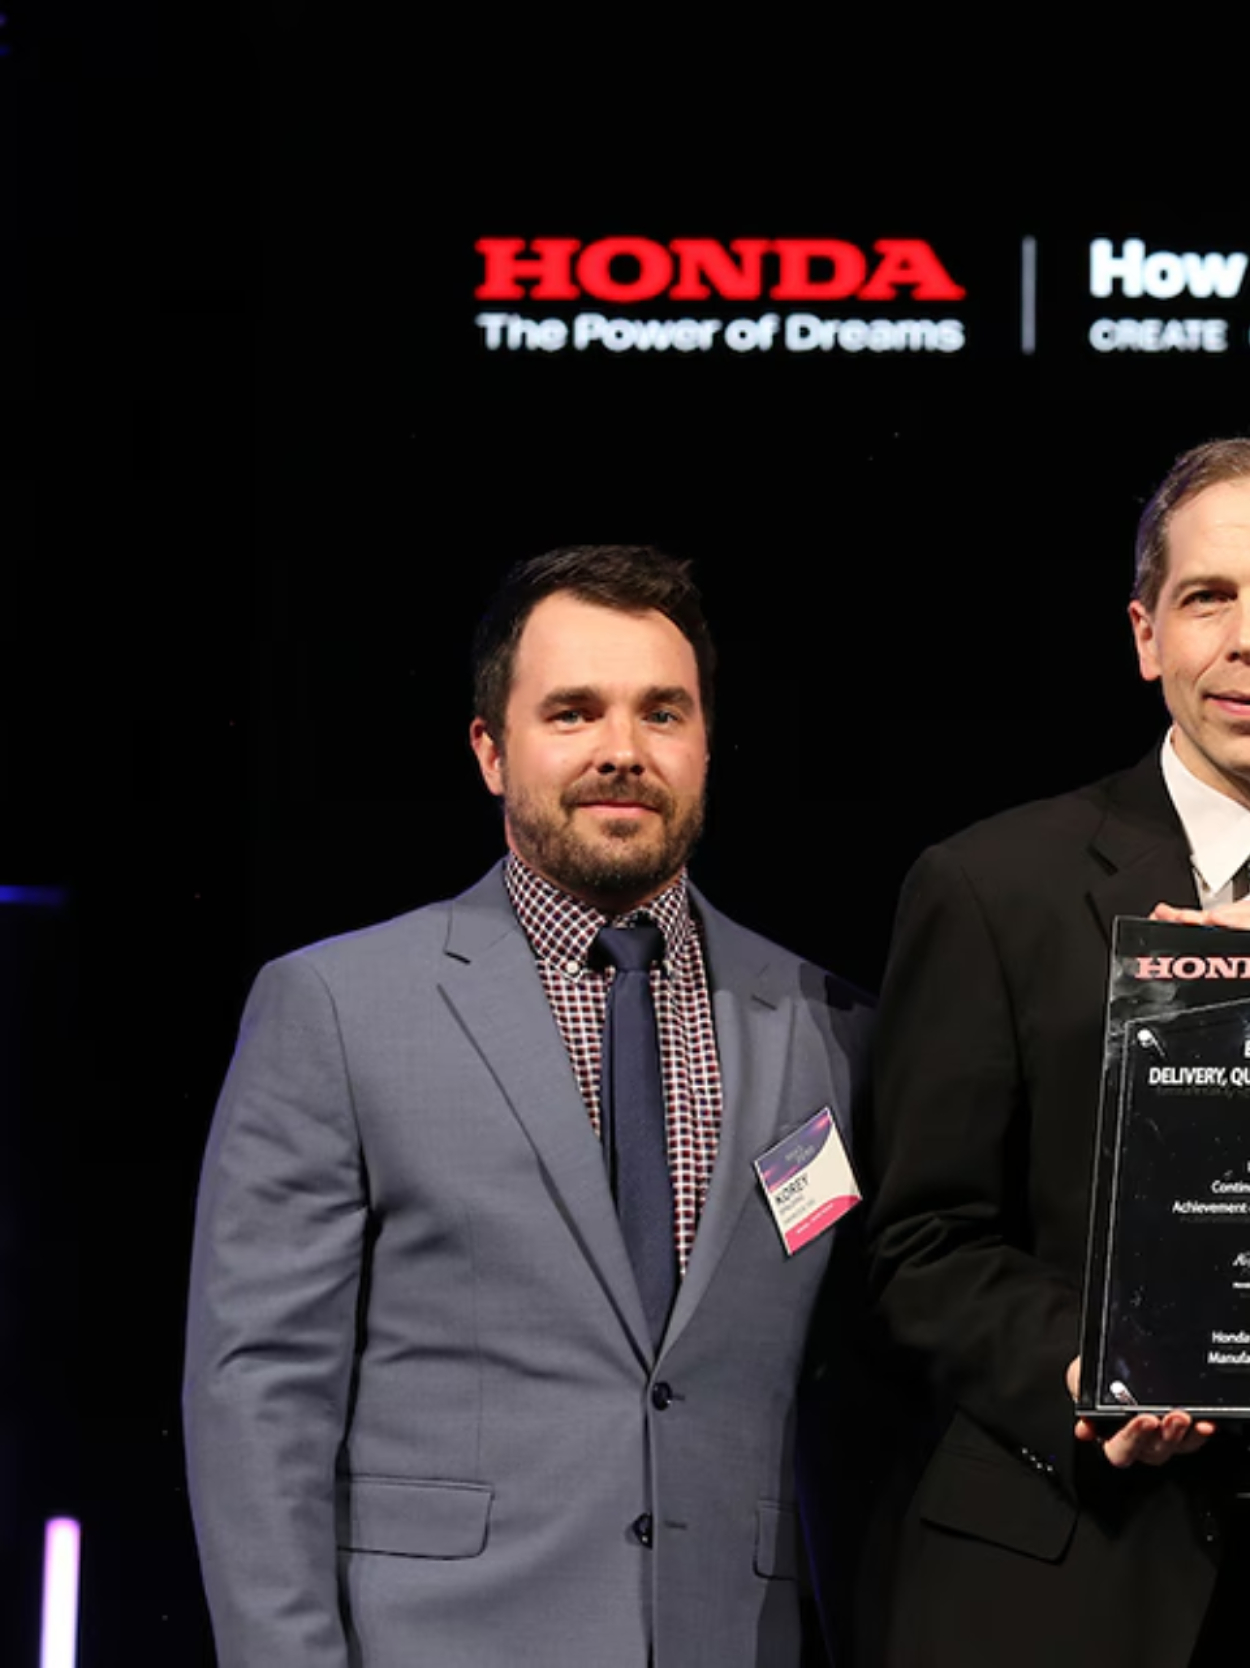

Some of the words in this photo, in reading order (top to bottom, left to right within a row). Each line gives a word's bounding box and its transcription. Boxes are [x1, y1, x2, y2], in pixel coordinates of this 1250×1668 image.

[475, 236, 966, 303] HONDA
[1090, 238, 1248, 299] How
[476, 313, 568, 351] The
[574, 313, 722, 351] Power
[725, 313, 779, 351] of
[785, 313, 965, 352] Dreams
[1089, 318, 1227, 352] CREATE
[1149, 1067, 1227, 1086] DELIVERY,
[1173, 1201, 1247, 1213] Achievement
[1212, 1331, 1250, 1343] Honda
